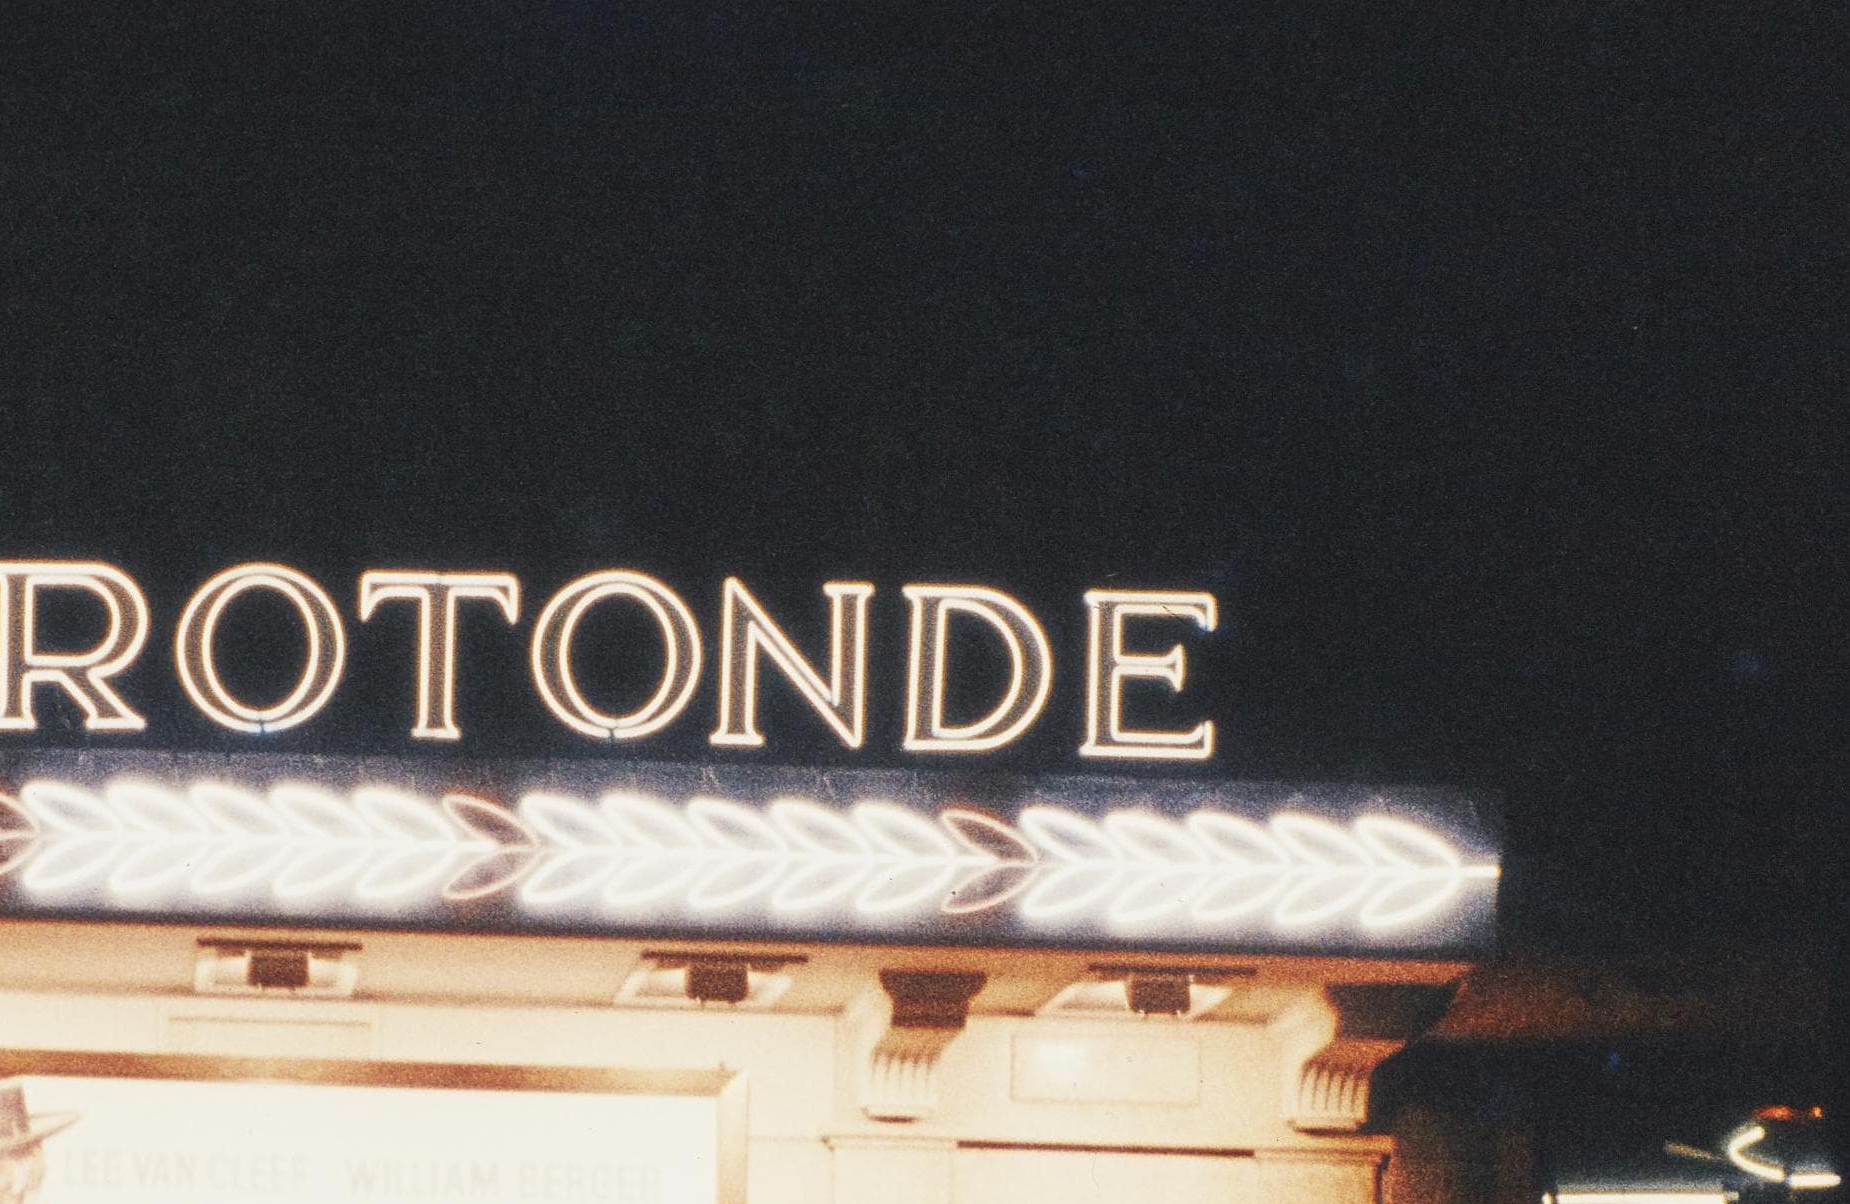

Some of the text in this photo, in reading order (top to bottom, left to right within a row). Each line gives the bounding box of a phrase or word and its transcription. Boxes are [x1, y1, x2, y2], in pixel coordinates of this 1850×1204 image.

[62, 1146, 663, 1204] LEE VAN CLEEF WILLIAM BERGER
